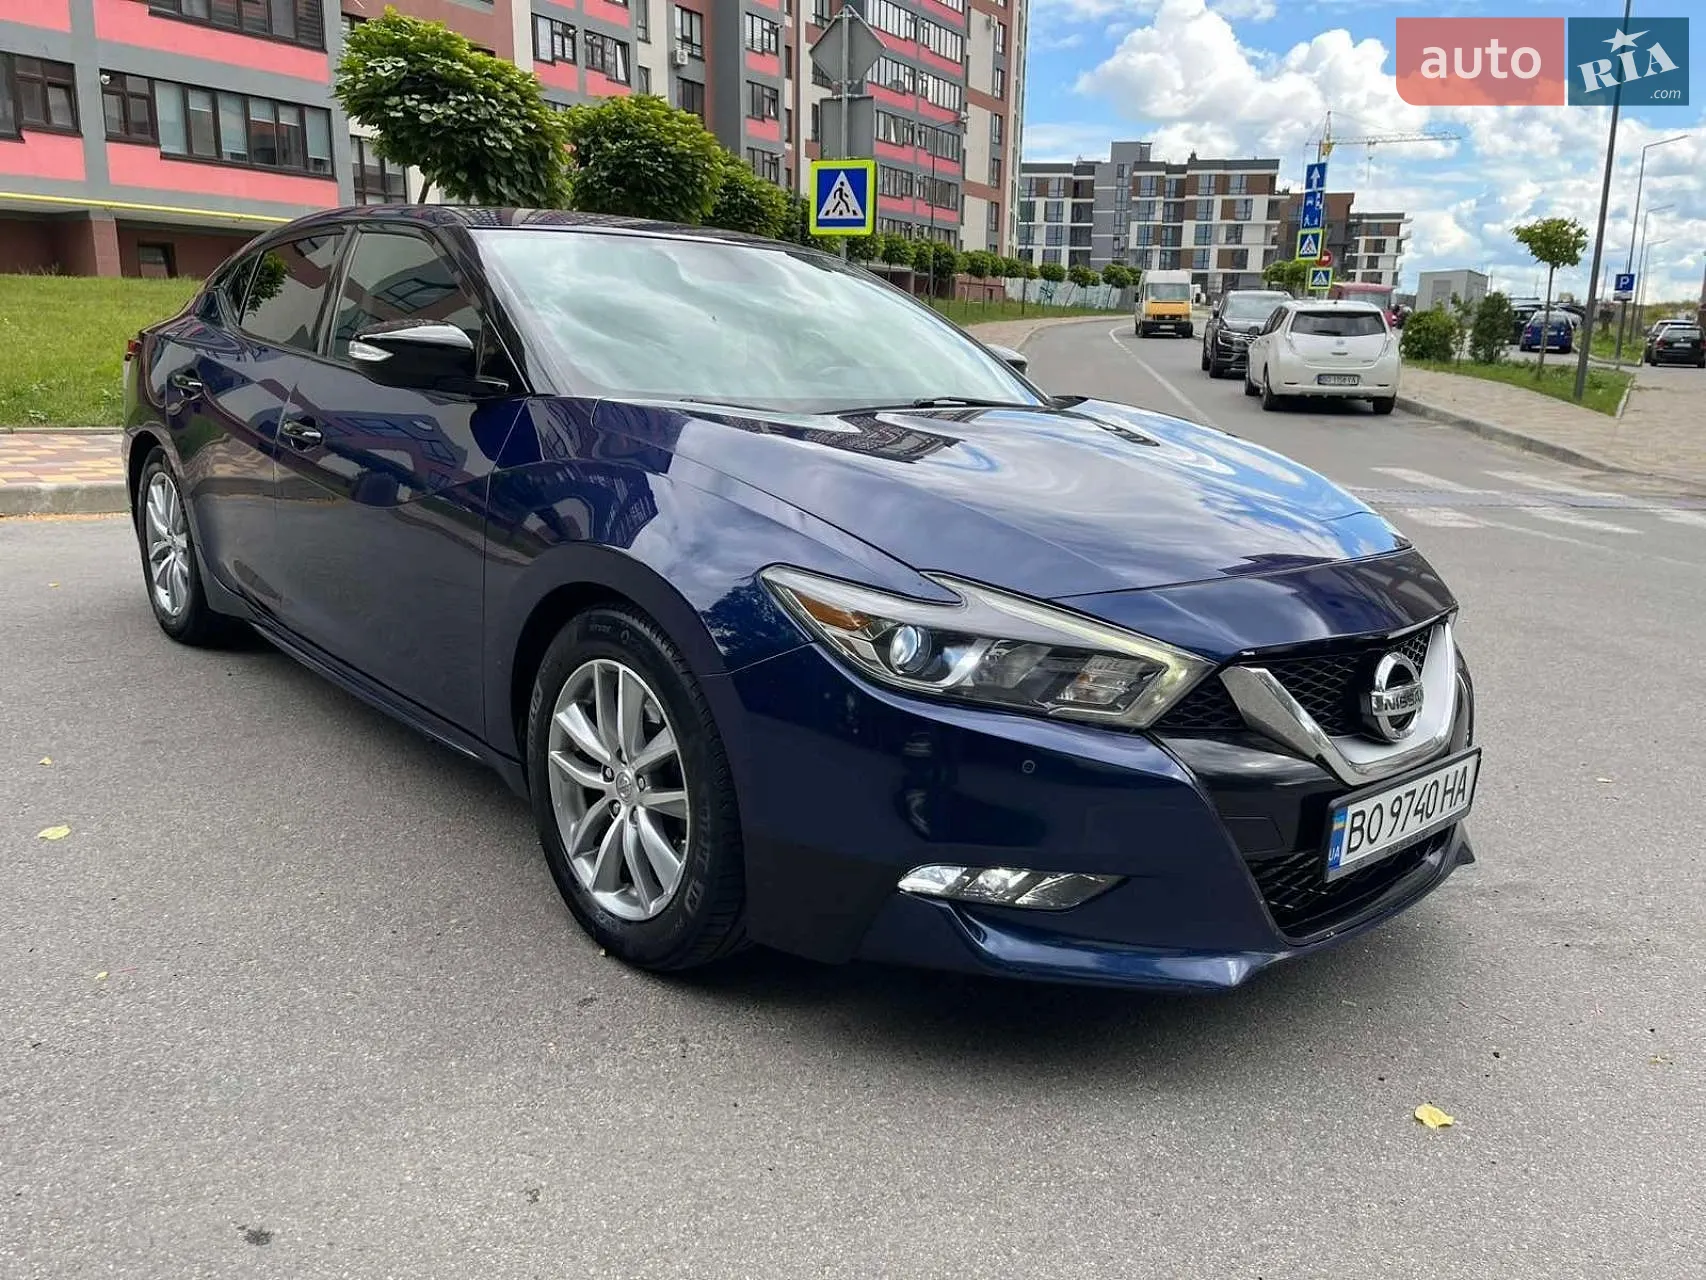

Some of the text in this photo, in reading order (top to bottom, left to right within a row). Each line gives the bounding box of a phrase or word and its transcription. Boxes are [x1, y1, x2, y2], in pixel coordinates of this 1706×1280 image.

[1620, 276, 1630, 288] P
[1384, 687, 1423, 710] NISSA
[1347, 803, 1384, 855] BO
[1387, 780, 1439, 838] 9740
[1440, 766, 1468, 813] HA
[1328, 846, 1340, 861] UA
